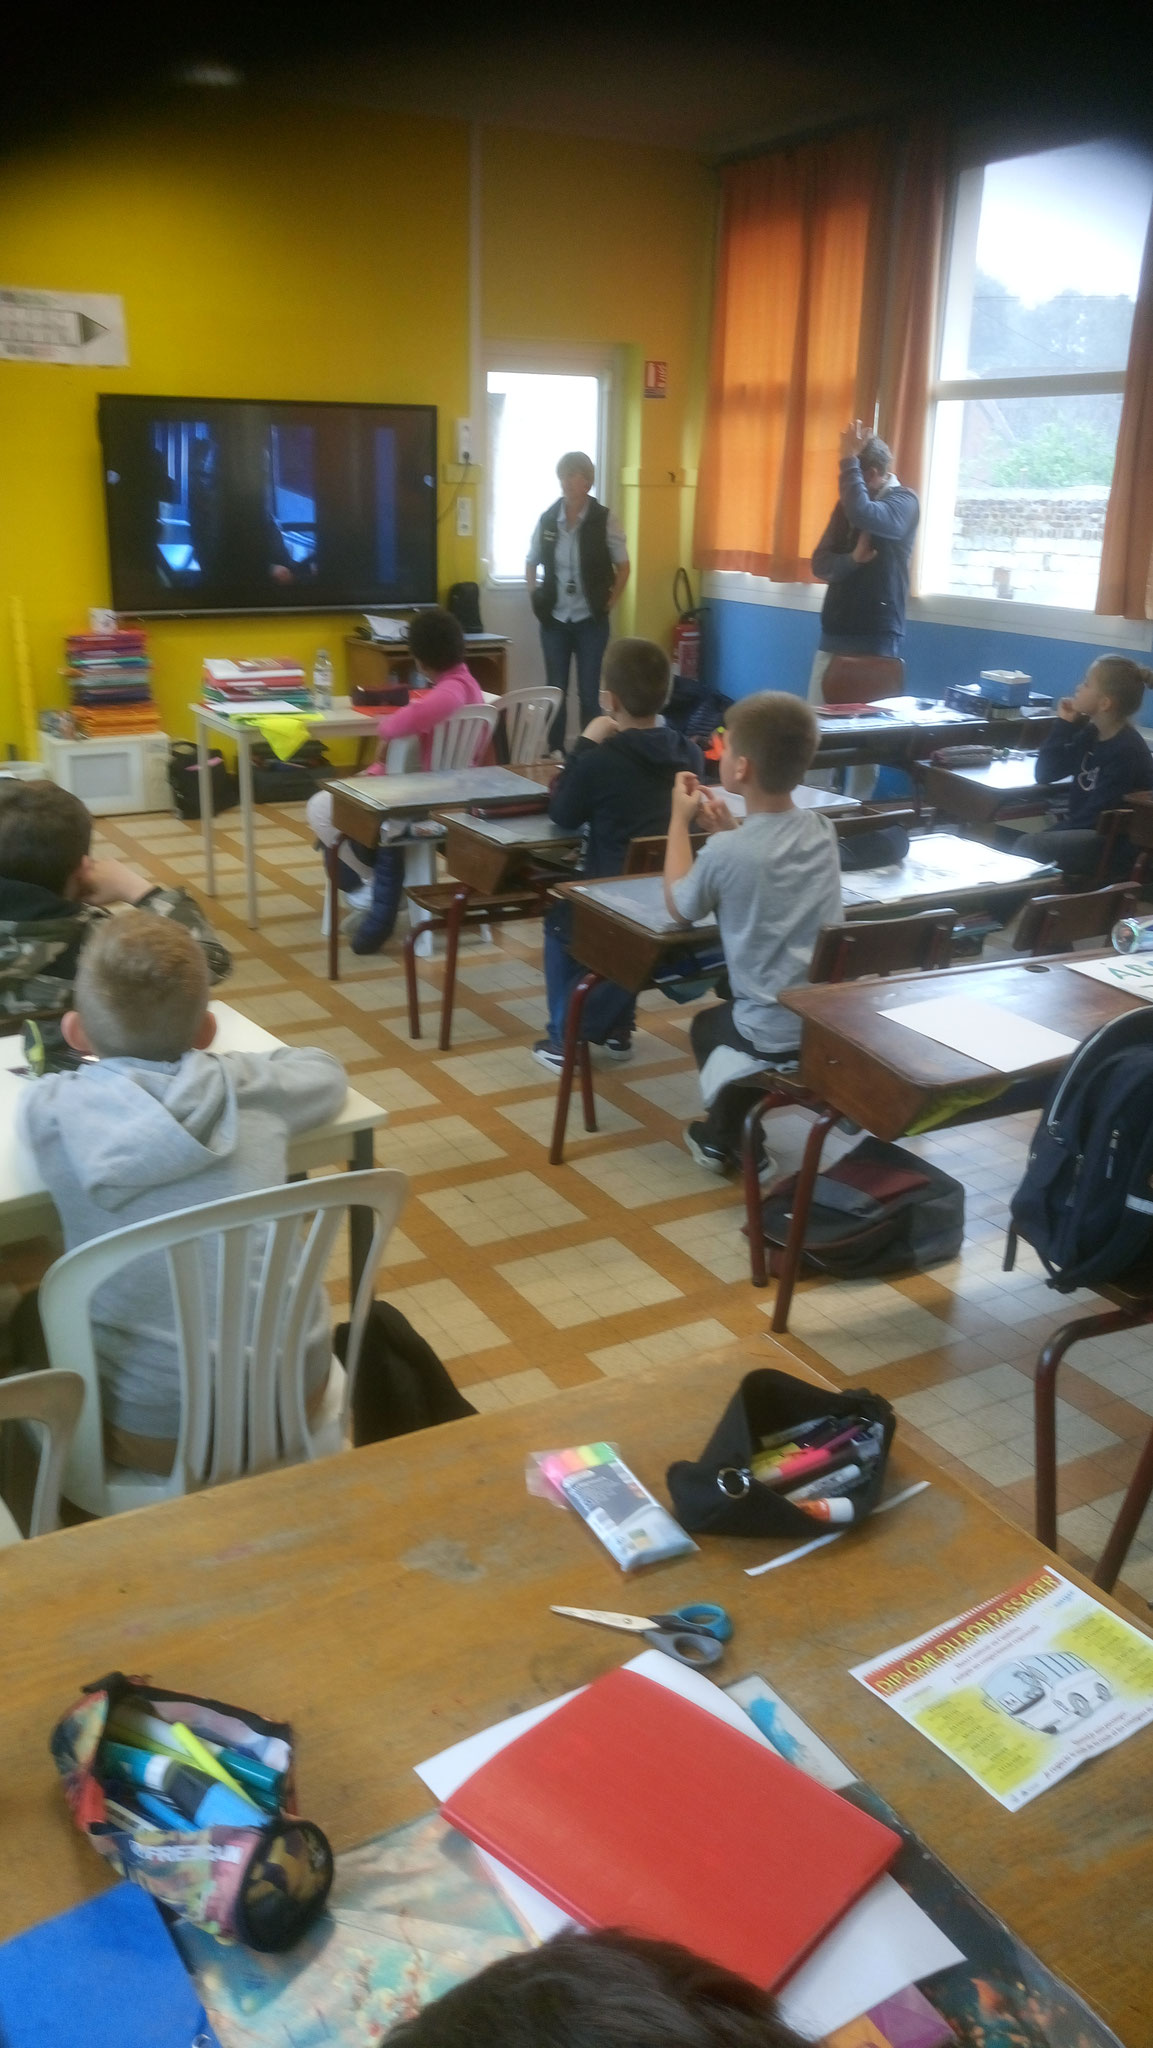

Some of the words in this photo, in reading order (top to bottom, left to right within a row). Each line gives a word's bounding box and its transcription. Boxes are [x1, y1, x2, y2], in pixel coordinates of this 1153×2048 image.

[1106, 961, 1153, 980] AB
[935, 1635, 963, 1656] DU
[956, 1618, 994, 1642] BON
[987, 1574, 1058, 1625] PASSAGER
